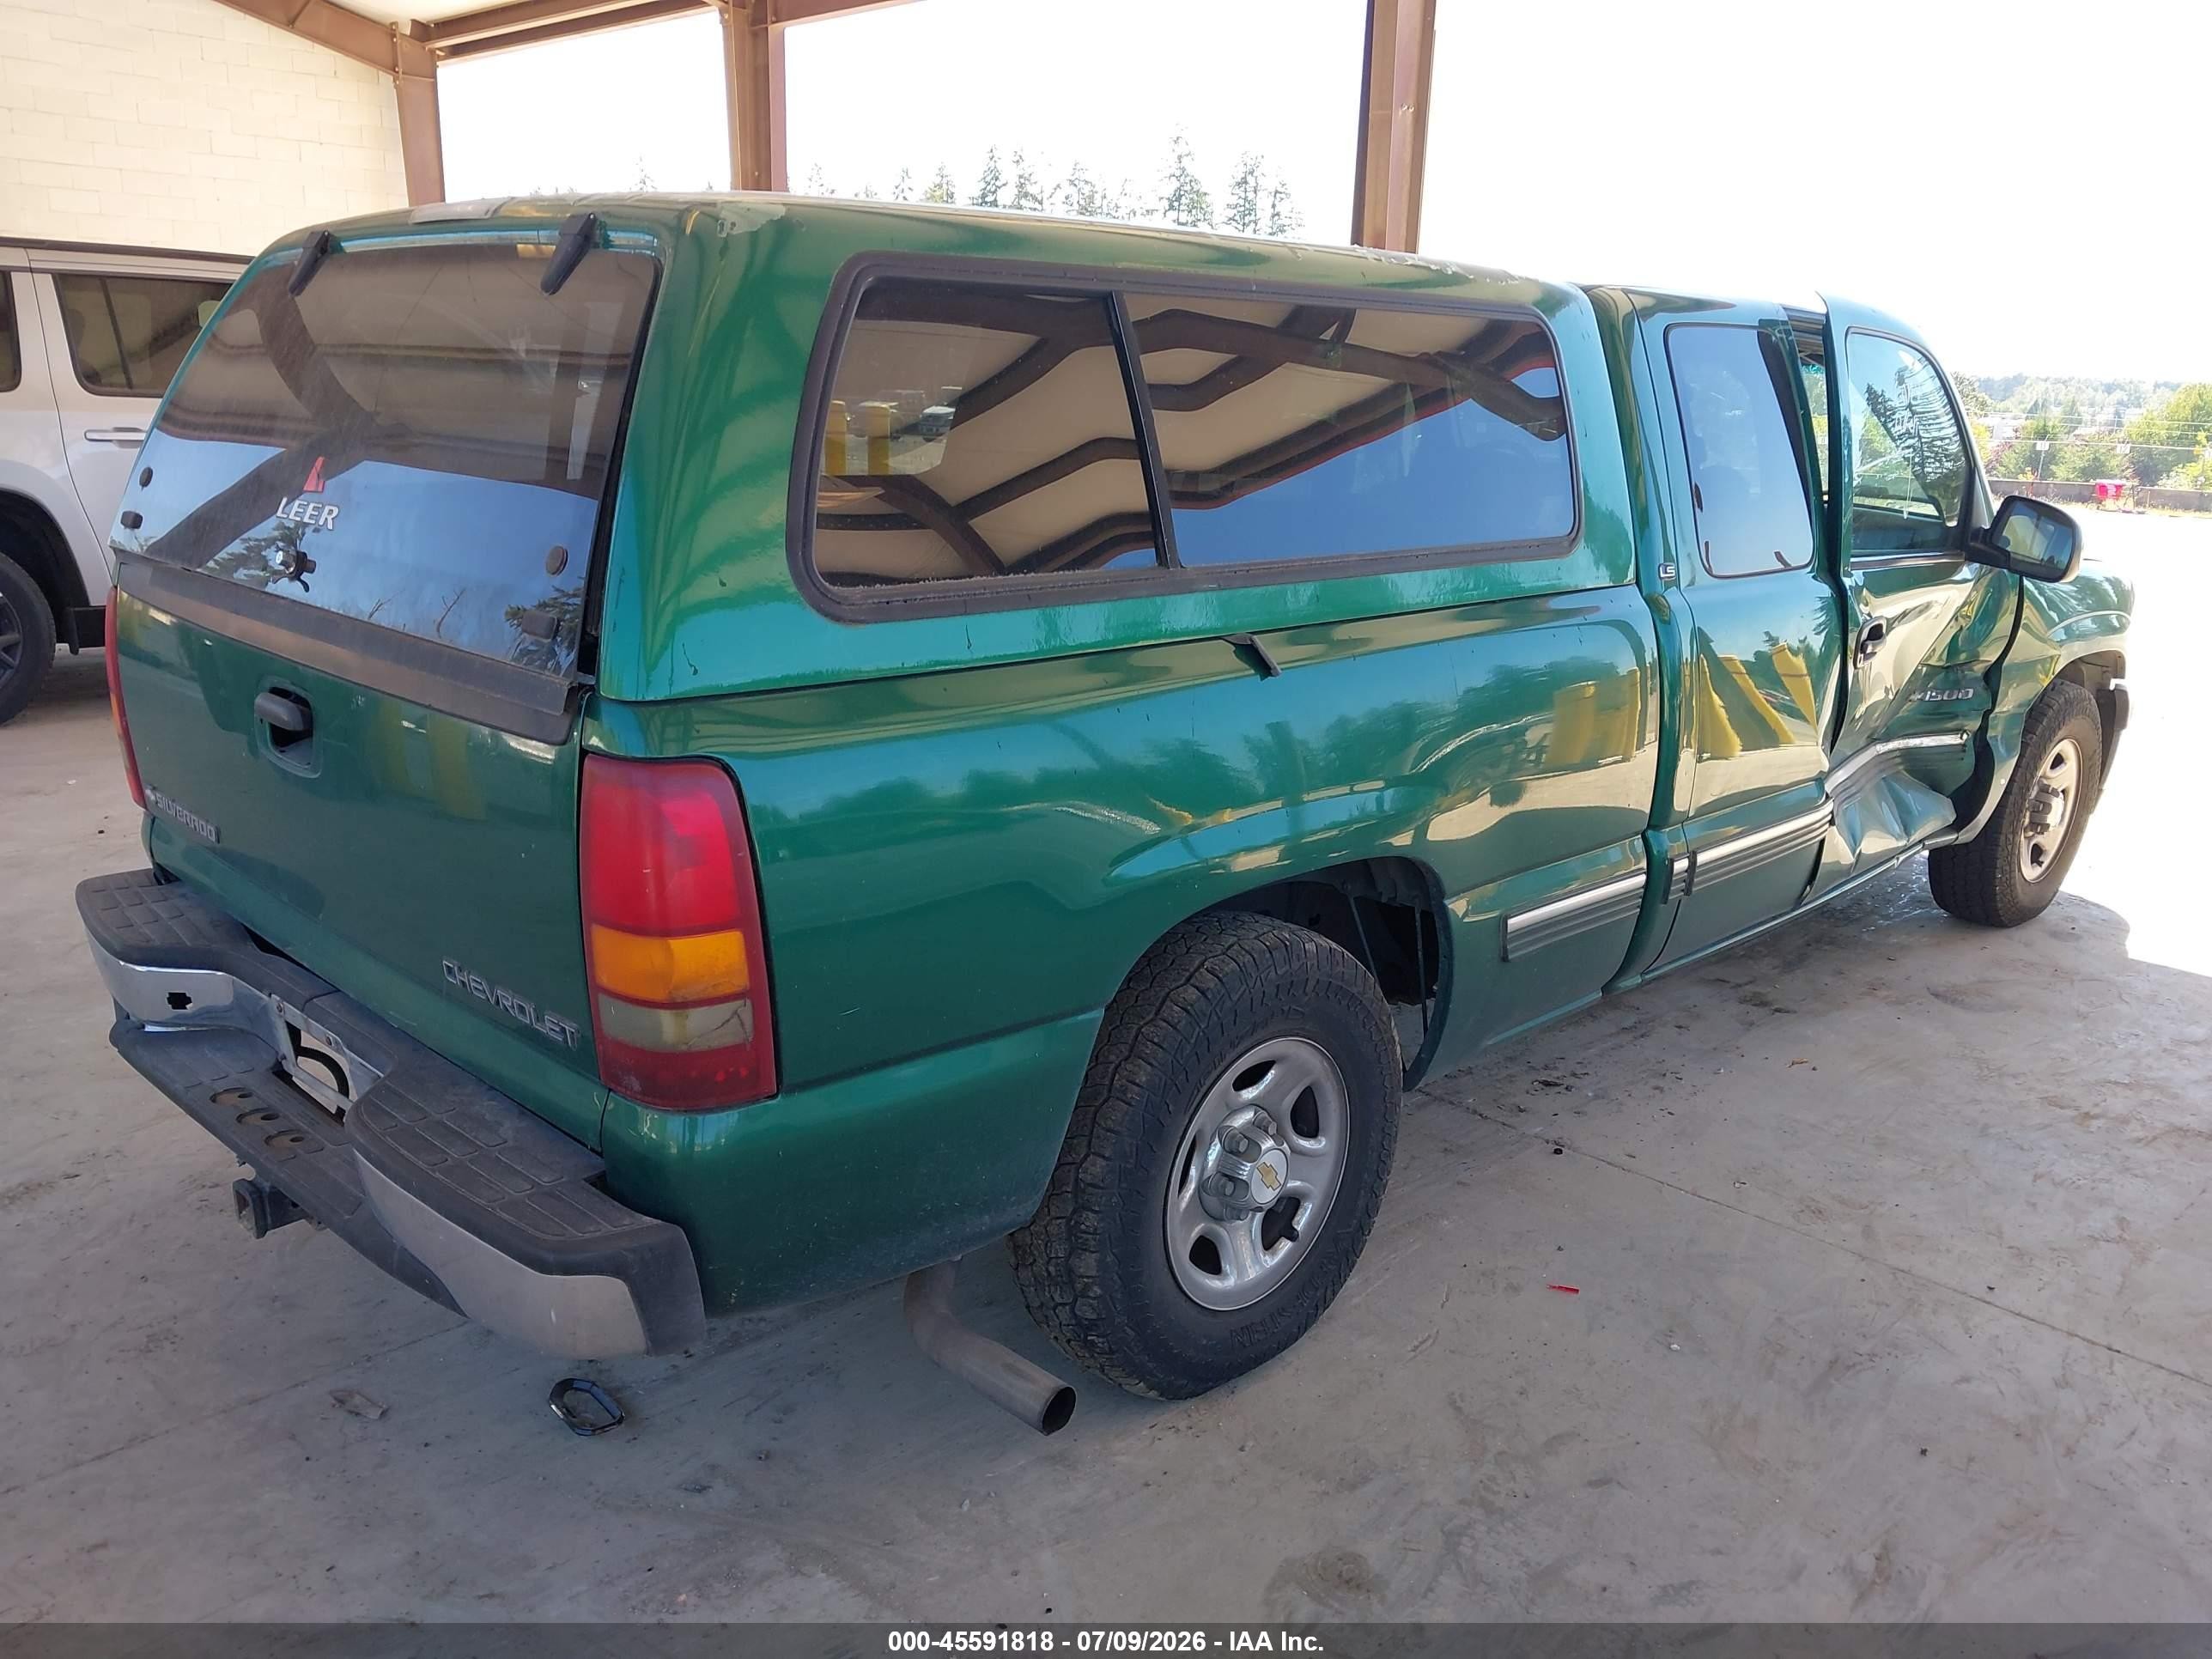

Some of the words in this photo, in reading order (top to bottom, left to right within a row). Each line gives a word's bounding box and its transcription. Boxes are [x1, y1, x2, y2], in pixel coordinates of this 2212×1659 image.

[275, 495, 340, 531] LEER
[1659, 566, 1675, 578] LS
[1923, 688, 1974, 702] 1500
[155, 792, 217, 843] SILVERADO
[442, 959, 578, 1050] CHEVROLET
